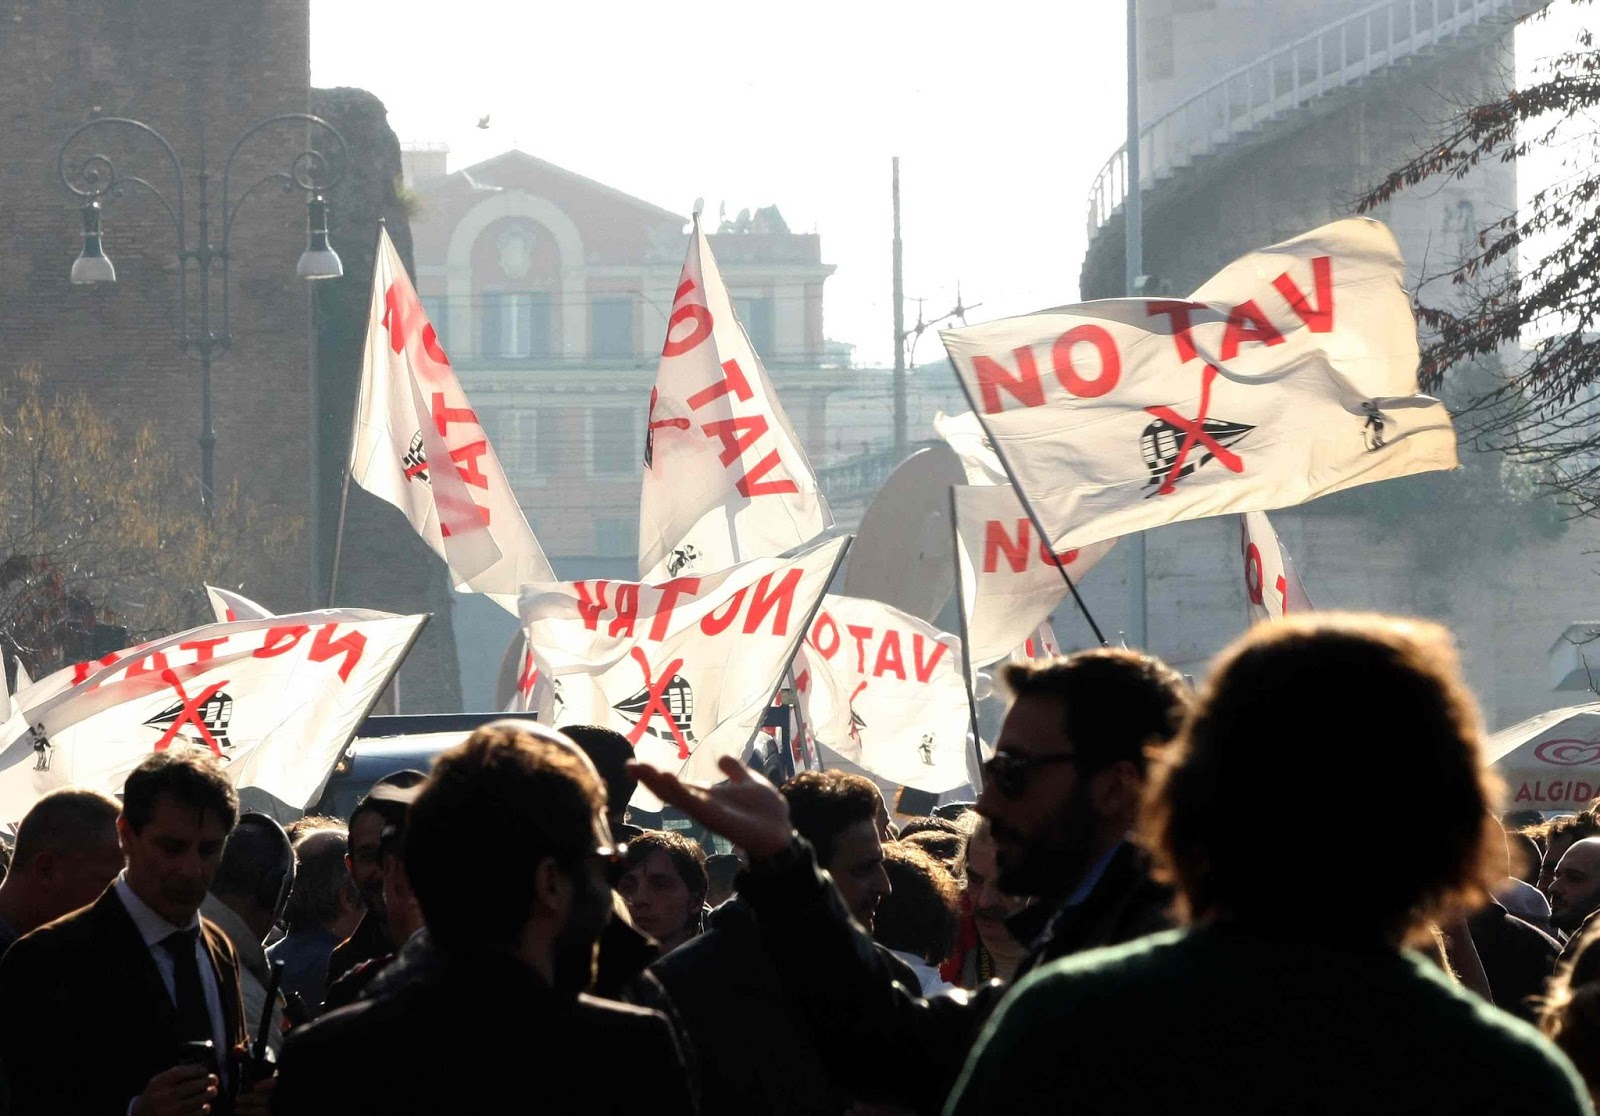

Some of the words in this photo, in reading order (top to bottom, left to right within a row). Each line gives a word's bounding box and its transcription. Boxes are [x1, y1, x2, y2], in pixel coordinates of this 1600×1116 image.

[972, 324, 1121, 415] NO
[1146, 256, 1334, 364] TAV
[686, 358, 799, 498] TAV
[846, 624, 949, 684] TAV
